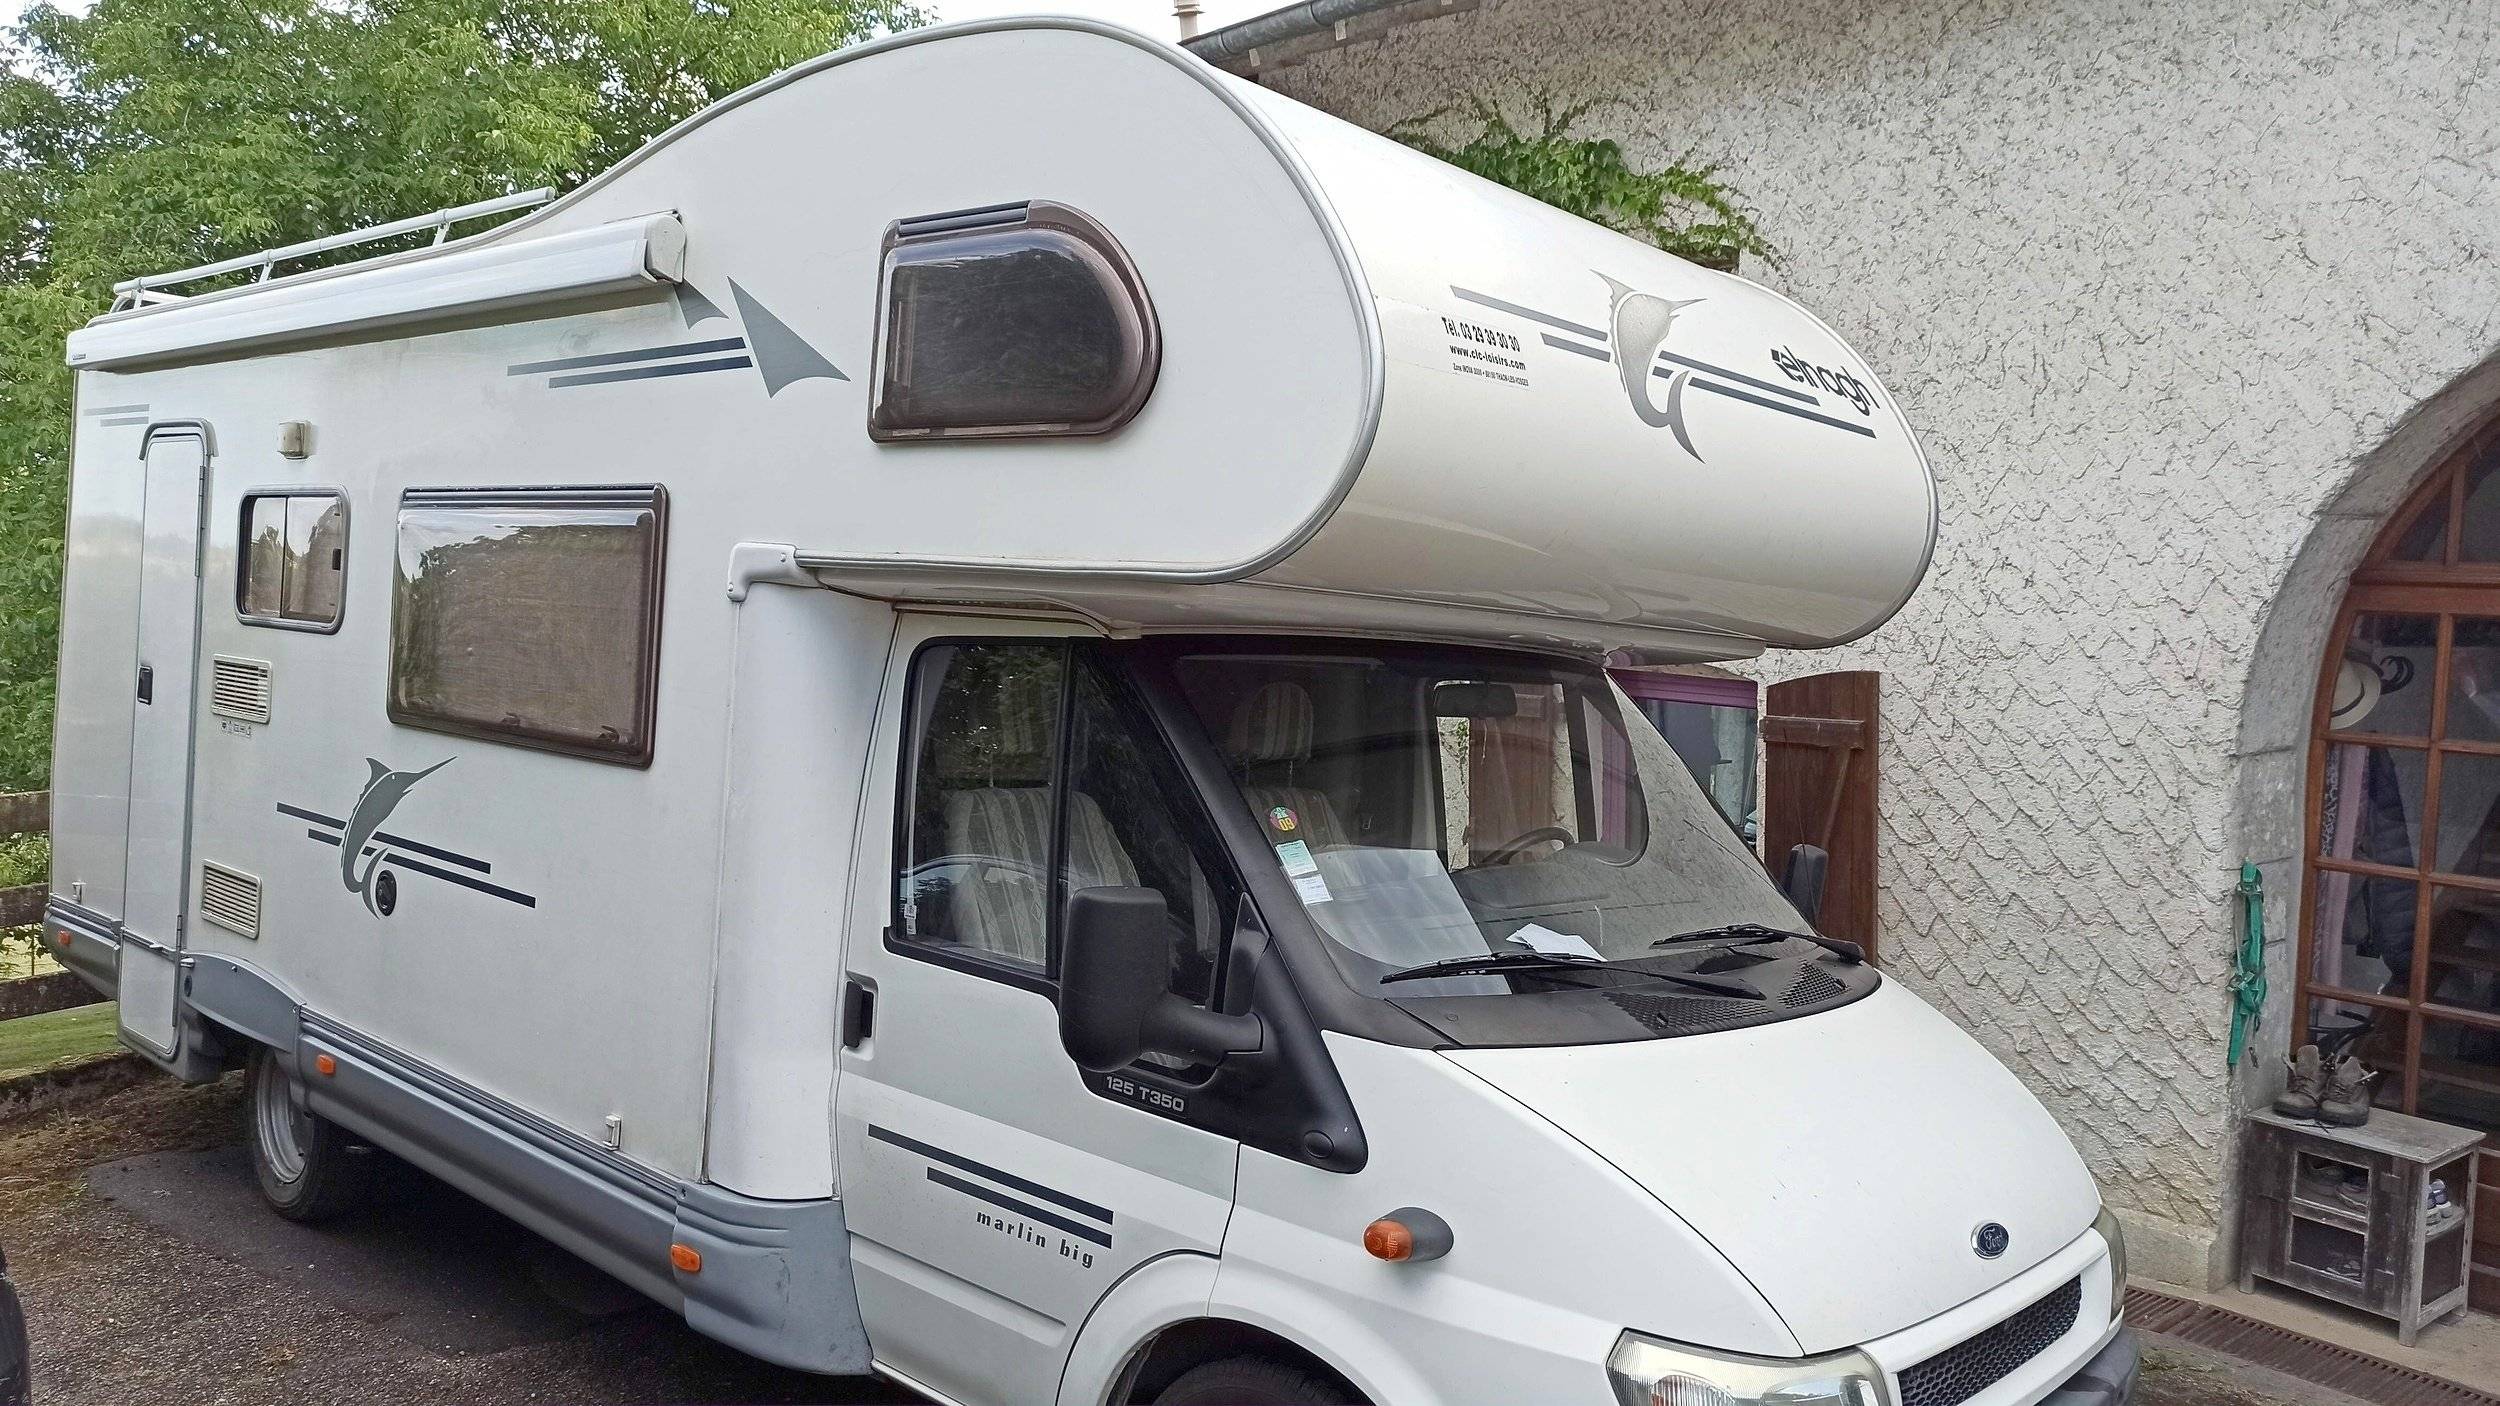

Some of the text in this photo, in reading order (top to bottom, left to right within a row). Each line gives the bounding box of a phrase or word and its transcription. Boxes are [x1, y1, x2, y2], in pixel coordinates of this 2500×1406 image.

[1441, 316, 1521, 353] Tél. 03 29 39 30 30
[1449, 344, 1526, 371] www.clc-loisirs.com
[1770, 344, 1881, 417] elnagh
[1106, 1075, 1184, 1112] 125 T350
[976, 1211, 1094, 1269] marlin big
